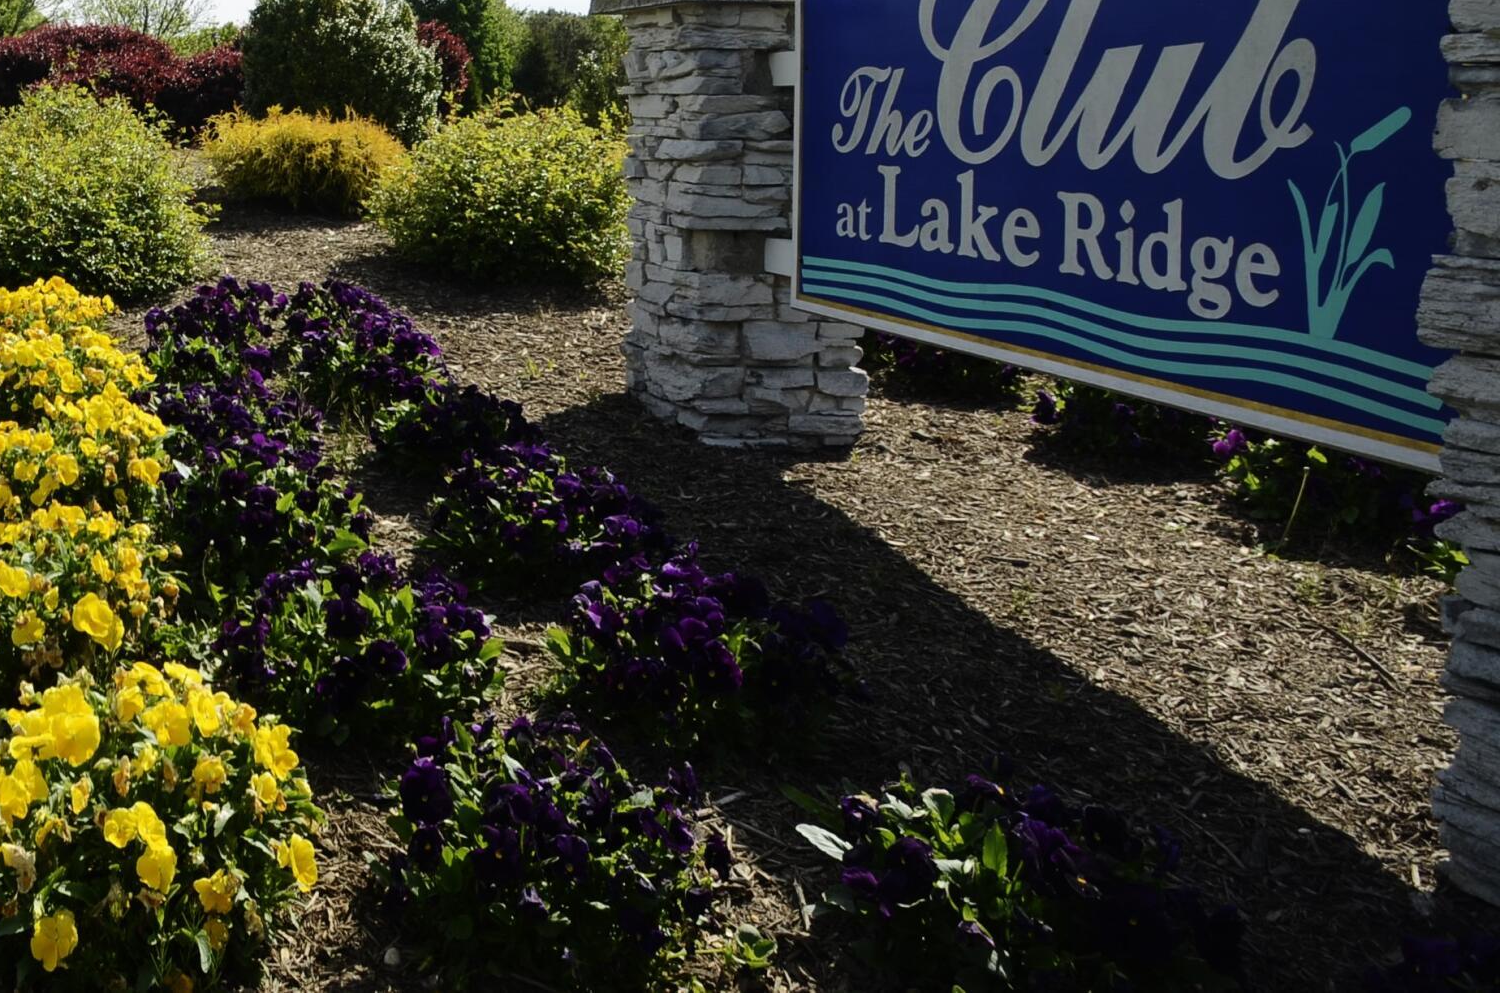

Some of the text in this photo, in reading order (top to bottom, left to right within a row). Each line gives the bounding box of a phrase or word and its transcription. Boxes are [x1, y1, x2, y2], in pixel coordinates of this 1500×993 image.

[831, 66, 932, 158] The
[836, 165, 1281, 319] at Lake Ridge
